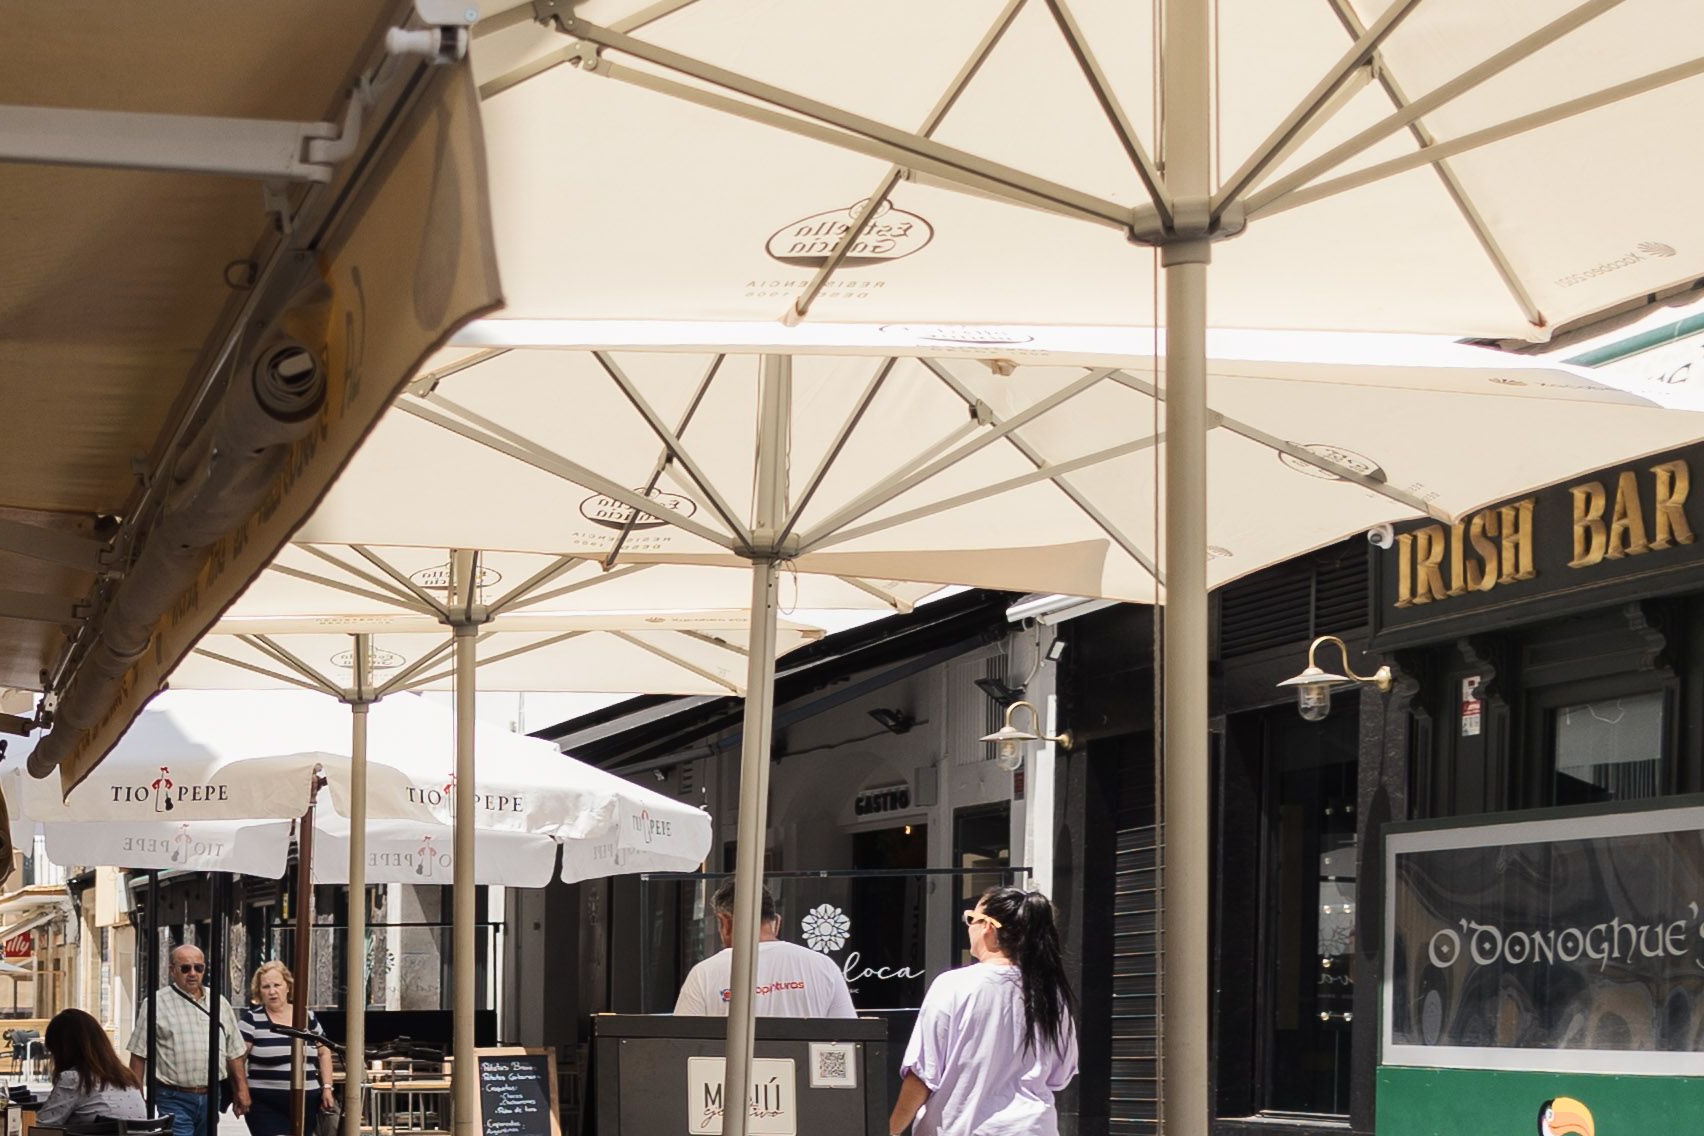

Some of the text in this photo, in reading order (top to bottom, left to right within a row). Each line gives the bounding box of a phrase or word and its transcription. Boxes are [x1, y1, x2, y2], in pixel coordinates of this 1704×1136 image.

[1392, 458, 1696, 610] IRISH BAR
[110, 784, 229, 802] TIO PEPE
[405, 786, 442, 807] TIO
[854, 788, 911, 818] GASTRO
[6, 935, 30, 956] illy
[843, 951, 927, 983] loca
[704, 1076, 780, 1111] MÚ
